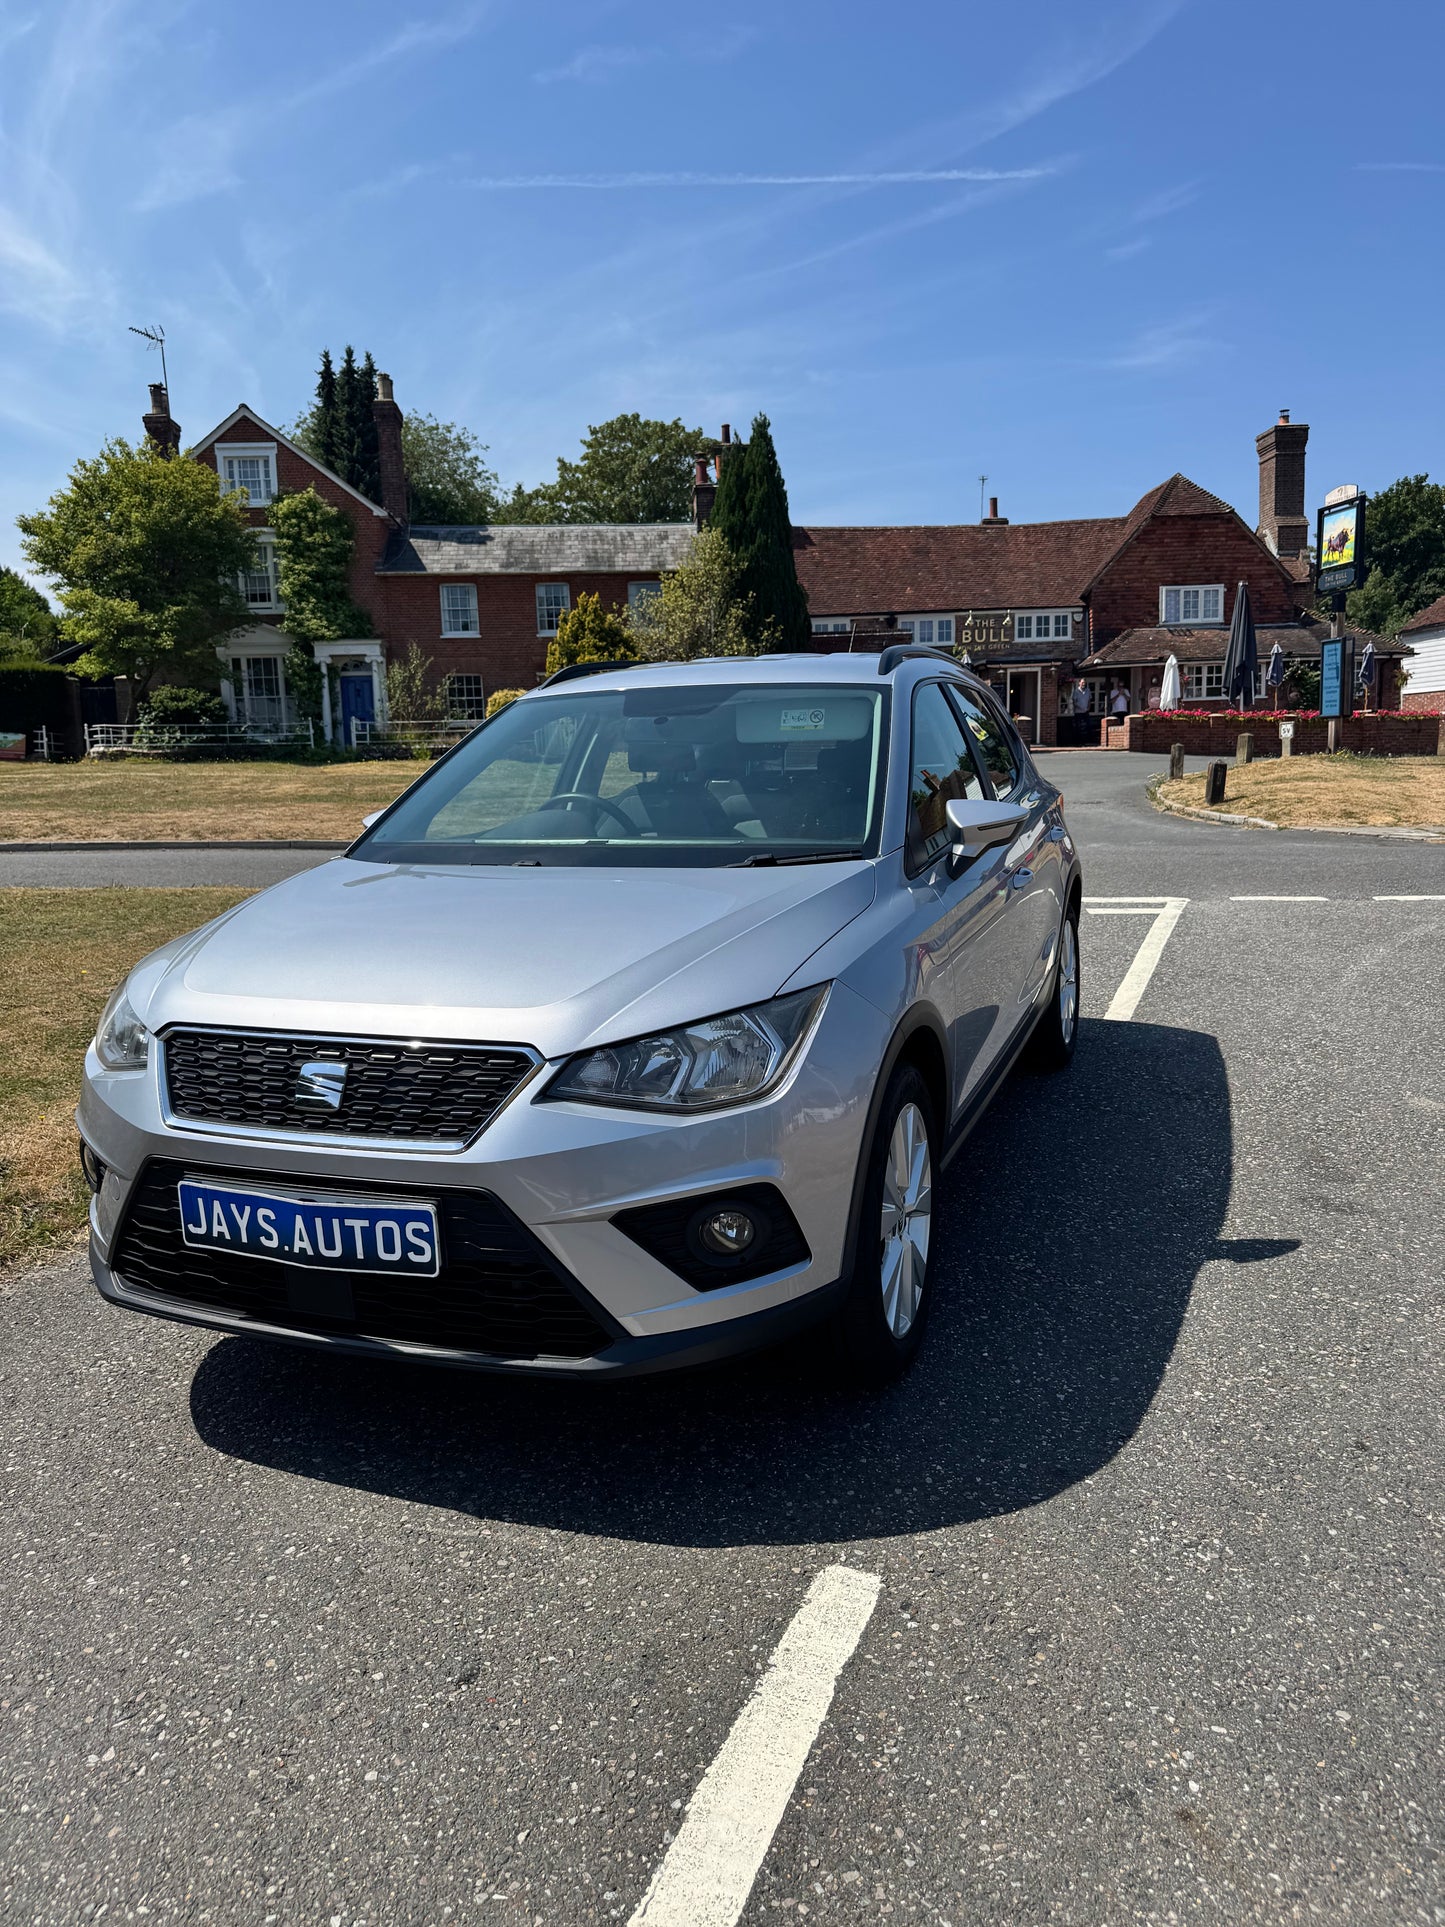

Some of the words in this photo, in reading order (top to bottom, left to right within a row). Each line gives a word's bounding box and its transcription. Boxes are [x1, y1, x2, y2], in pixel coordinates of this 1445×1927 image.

[975, 619, 996, 627] THE
[962, 628, 1010, 643] BULL
[187, 1197, 432, 1263] JAYS.AUTOS
